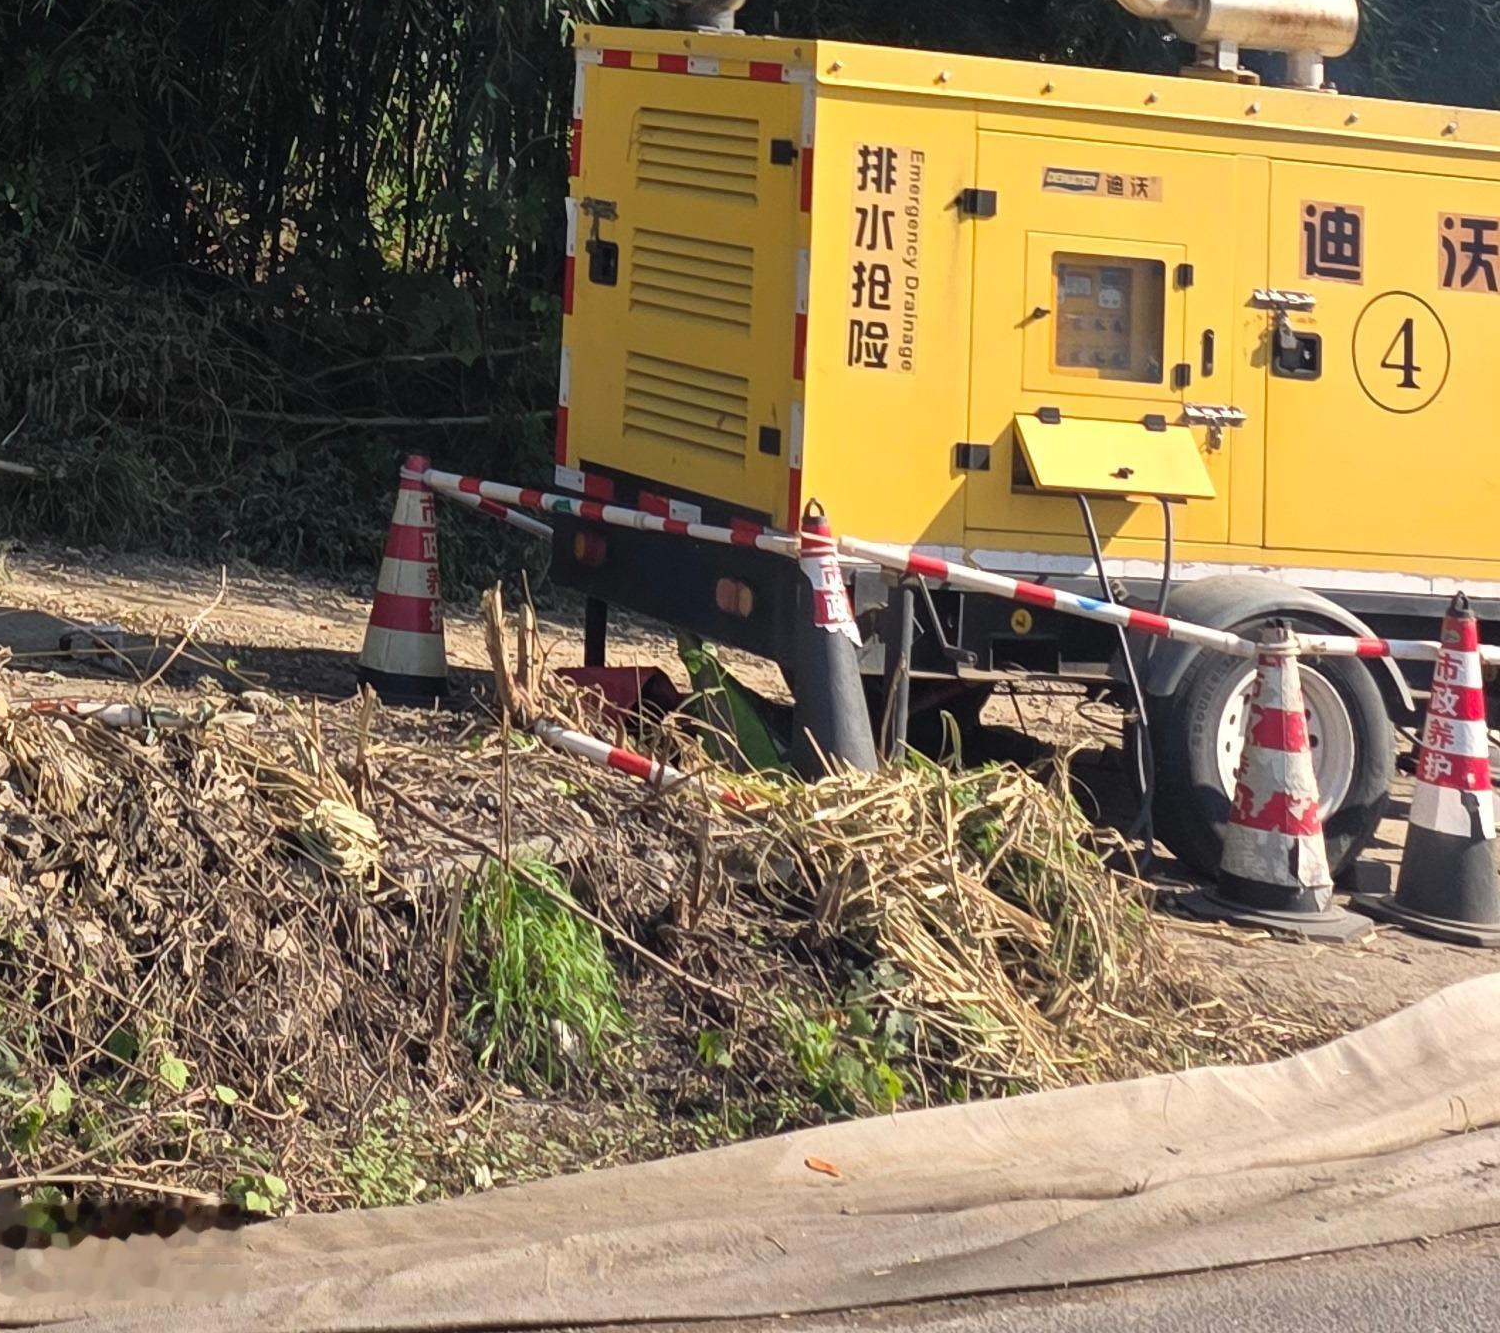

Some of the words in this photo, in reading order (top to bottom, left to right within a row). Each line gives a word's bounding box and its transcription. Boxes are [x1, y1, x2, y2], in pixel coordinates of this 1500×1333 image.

[902, 150, 926, 269] Emergency
[1105, 173, 1149, 199] 迪沃
[847, 144, 898, 370] 排水抢险
[1303, 203, 1499, 293] 迪沃
[898, 275, 920, 371] Drainage
[1423, 652, 1463, 782] 市政养护
